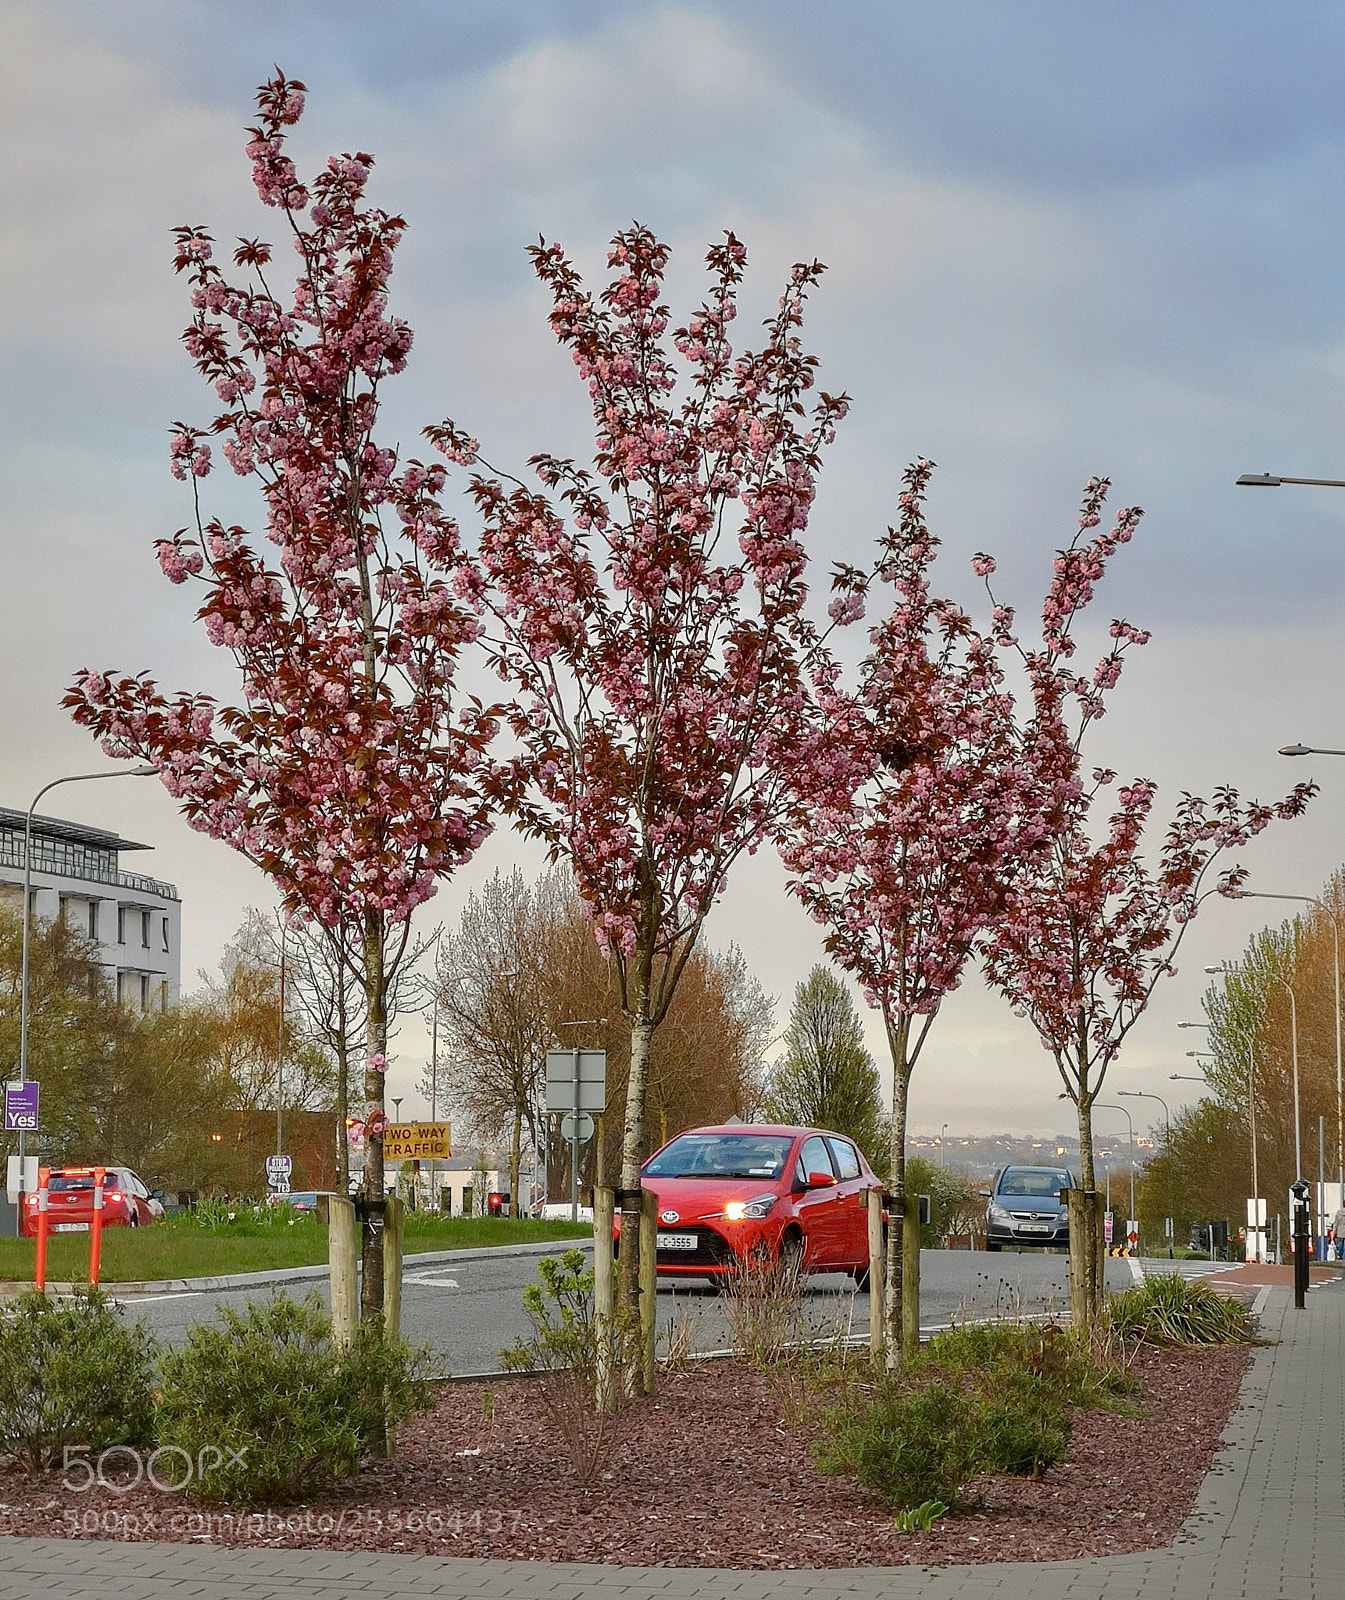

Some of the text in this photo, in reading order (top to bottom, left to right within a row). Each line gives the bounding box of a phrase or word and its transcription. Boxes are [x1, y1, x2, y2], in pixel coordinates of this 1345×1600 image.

[8, 1112, 36, 1127] Yes
[383, 1127, 446, 1140] TWO-WAY
[384, 1142, 444, 1155] TRAFFIC
[271, 1158, 287, 1166] STOP
[277, 1183, 290, 1193] YES
